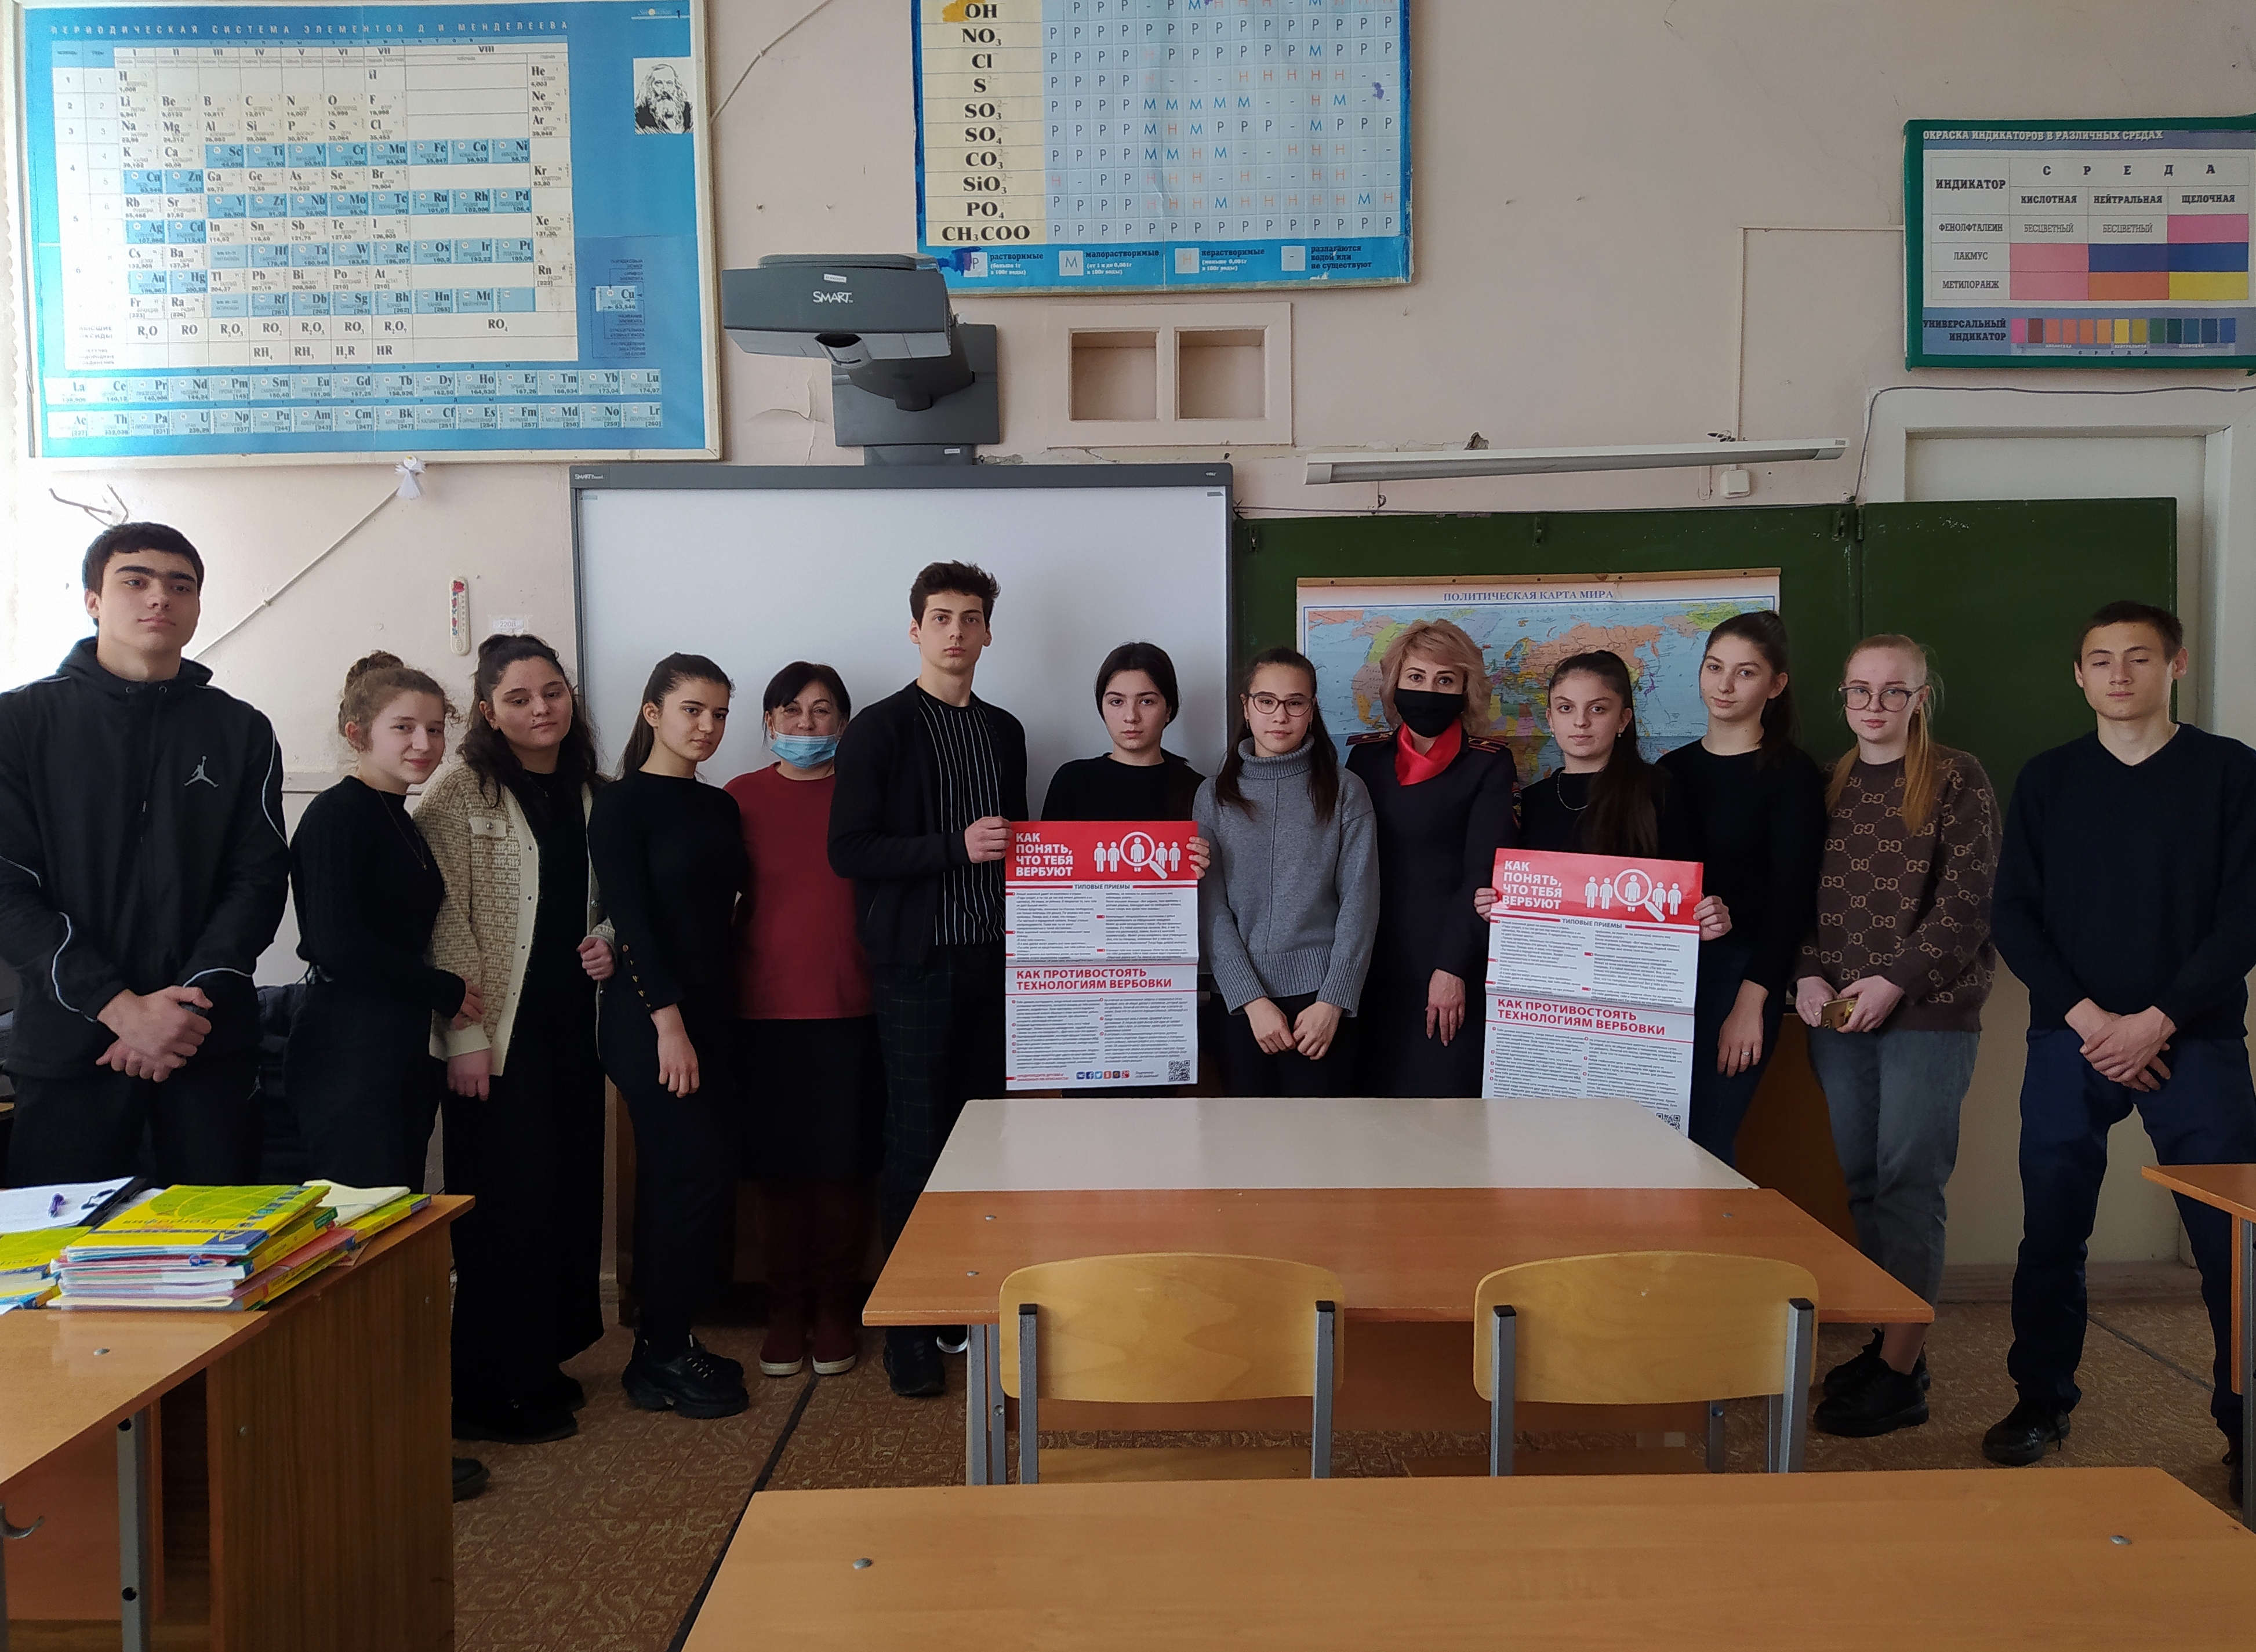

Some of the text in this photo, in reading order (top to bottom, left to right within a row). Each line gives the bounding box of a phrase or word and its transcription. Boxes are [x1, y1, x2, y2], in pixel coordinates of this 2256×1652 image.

[50, 25, 198, 35] ПЕРИОДИЧЕСКАЯ
[212, 25, 290, 35] СИСТЕМА
[304, 23, 404, 34] ЭЛЕМЕНТОВ
[458, 20, 568, 32] МЕНДЕЛЕЕВА
[531, 66, 545, 76] He
[120, 91, 546, 107] Li Be B C N O F Ne
[121, 115, 544, 135] Na Mg Al Si P S Cl Ar
[1923, 130, 2163, 141] ОКРАСКА ИНДИКАТОРОВ В РАЗЛИЧНЫХ СРЕДАХ
[123, 140, 528, 157] K Ca Fe Co Ni
[188, 166, 547, 183] Zn Kr
[1935, 179, 2006, 191] ИНДИКАТОР
[2021, 194, 2235, 205] КИСЛОТНАЯ НЕЙТРАЛЬНАЯ ЩЕЛОЧНАЯ
[149, 216, 549, 235] Ag Cd Xe
[1938, 223, 2153, 234] ФЕНОЛФТАЛЕИН БЕСЦВЕТНЫЙ БЕСЦВЕТНЫЙ
[1086, 250, 1159, 259] малорастворимые
[1202, 249, 1265, 257] нерастворимые
[1311, 246, 1361, 254] разлагаются
[990, 253, 1043, 261] растворимые
[1311, 253, 1334, 261] водой
[1953, 252, 1988, 261] ЛАКМУС
[1323, 262, 1372, 270] существуют
[1942, 280, 2000, 289] МЕТИЛОРАНЖ
[621, 289, 634, 299] Cu
[813, 291, 852, 303] SMART
[1923, 318, 2006, 328] УНИВЕРСАЛЬНЫЙ
[181, 325, 198, 334] RO
[1949, 333, 2006, 341] ИНДИКАТОР
[377, 345, 393, 355] HR
[604, 373, 659, 383] Yb Lu
[562, 406, 660, 416] Md No Lr
[1443, 590, 1613, 601] ПОЛИТИЧЕСКАЯ КАРТА МИРА
[1016, 832, 1040, 842] КАК
[1016, 844, 1073, 855] ПОНЯТЬ,
[1016, 856, 1073, 865] ЧТО ТЕБЯ
[1505, 860, 1530, 871] КАК
[1016, 867, 1073, 876] ВЕРБУЮТ
[1503, 872, 1562, 887] ПОНЯТЬ,
[1503, 883, 1562, 898] ЧТО ТЕБЯ
[1502, 895, 1561, 909] ВЕРБУЮТ
[1562, 918, 1593, 926] ТИПОВЫЕ
[1016, 969, 1146, 979] КАК ПРОТИВОСТОЯТЬ
[1016, 978, 1172, 990] ТЕХНОЛОГИЯМ ВЕРБОВКИ
[1498, 999, 1637, 1020] КАК ПРОТИВОСТОЯТЬ
[1498, 1010, 1665, 1035] ТЕХНОЛОГИЯМ ВЕРБОВКИ
